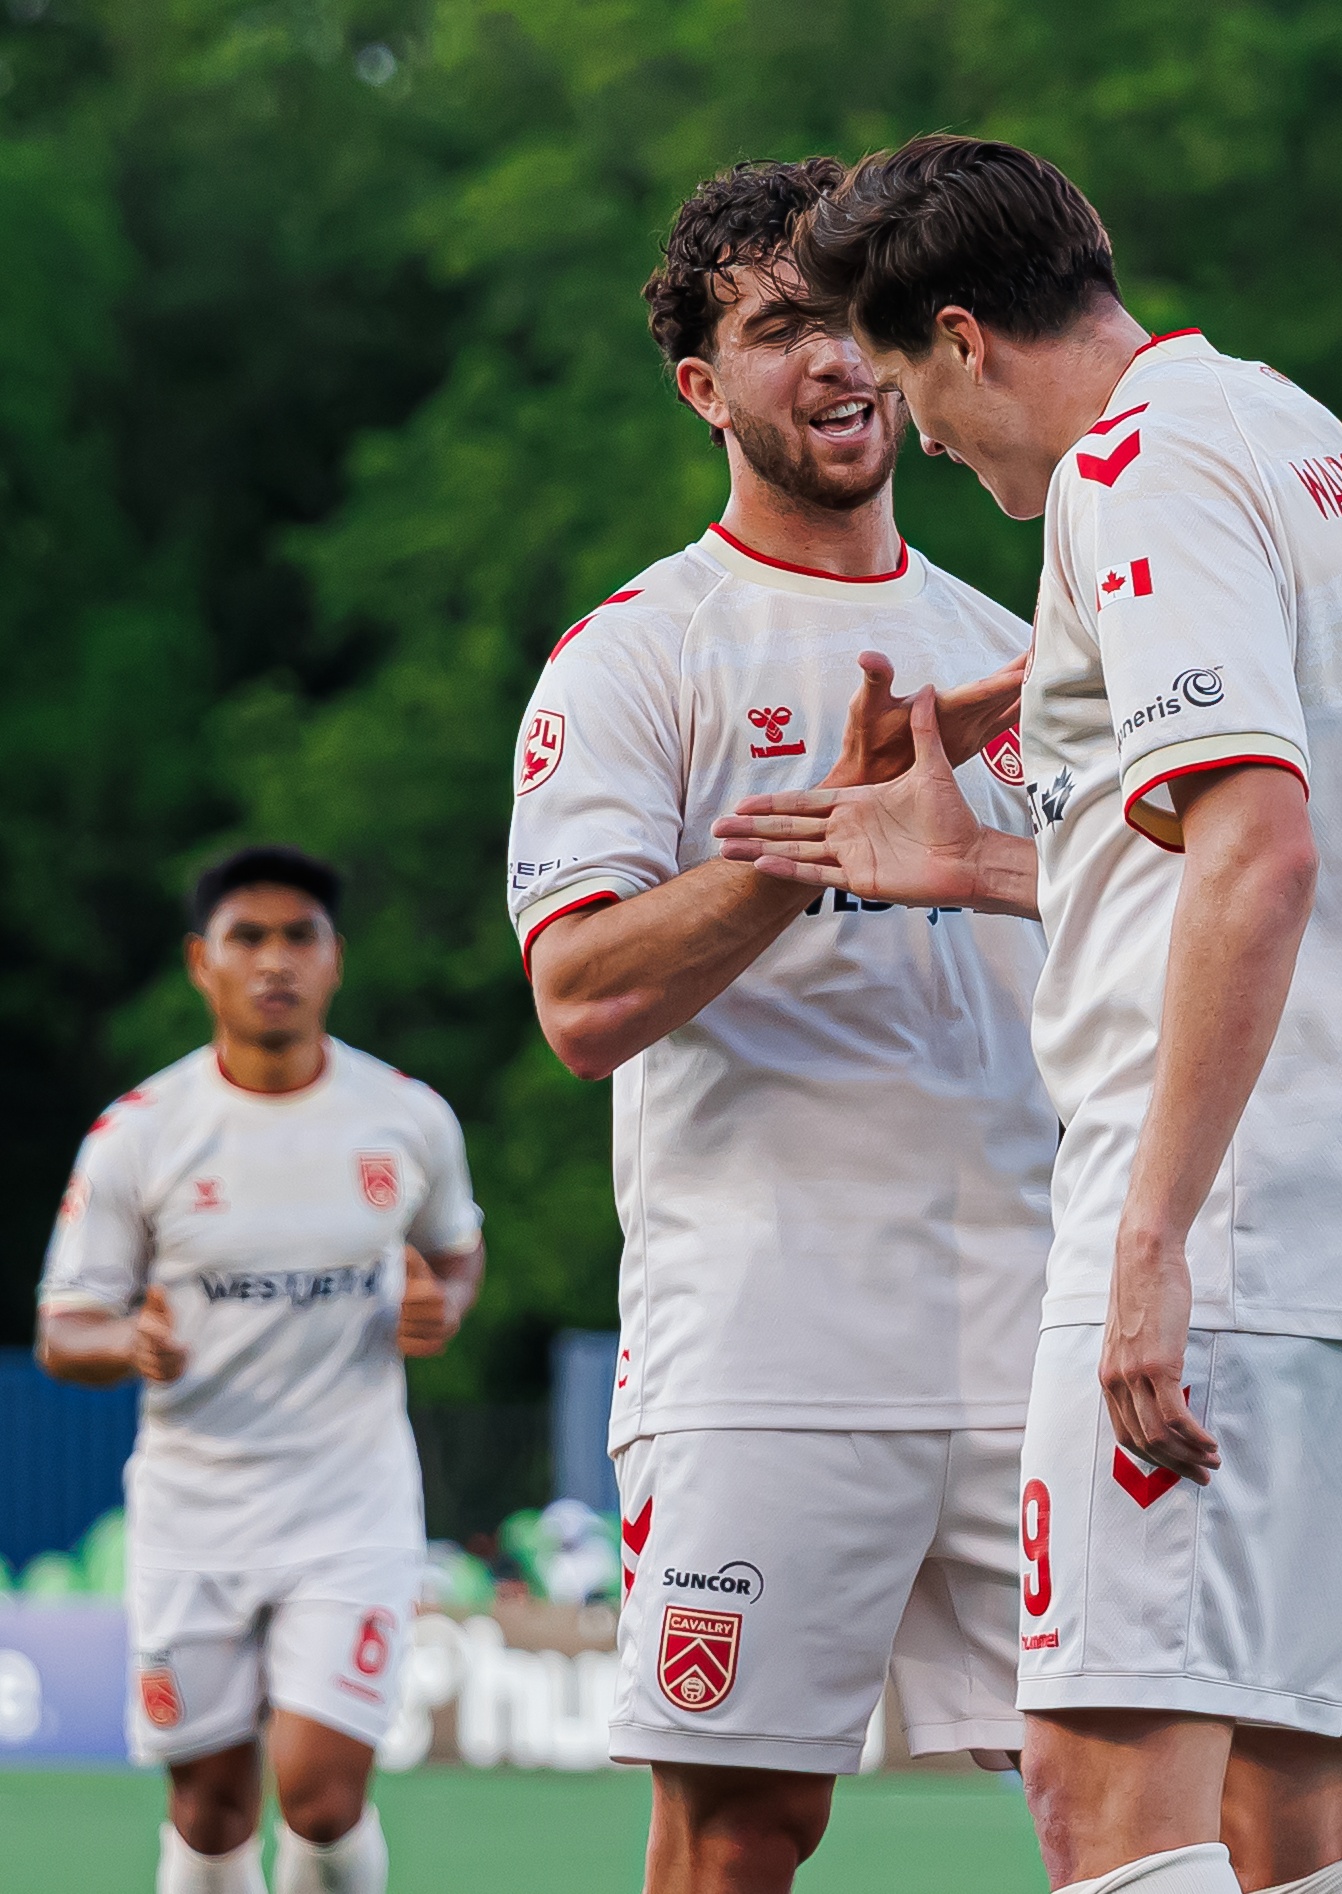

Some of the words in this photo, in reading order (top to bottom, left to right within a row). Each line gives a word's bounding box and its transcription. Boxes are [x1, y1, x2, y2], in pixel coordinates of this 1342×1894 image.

[1022, 1478, 1052, 1617] 9
[662, 1567, 751, 1596] SUNCOR
[352, 1607, 397, 1677] 6
[670, 1616, 733, 1635] CAVALRY
